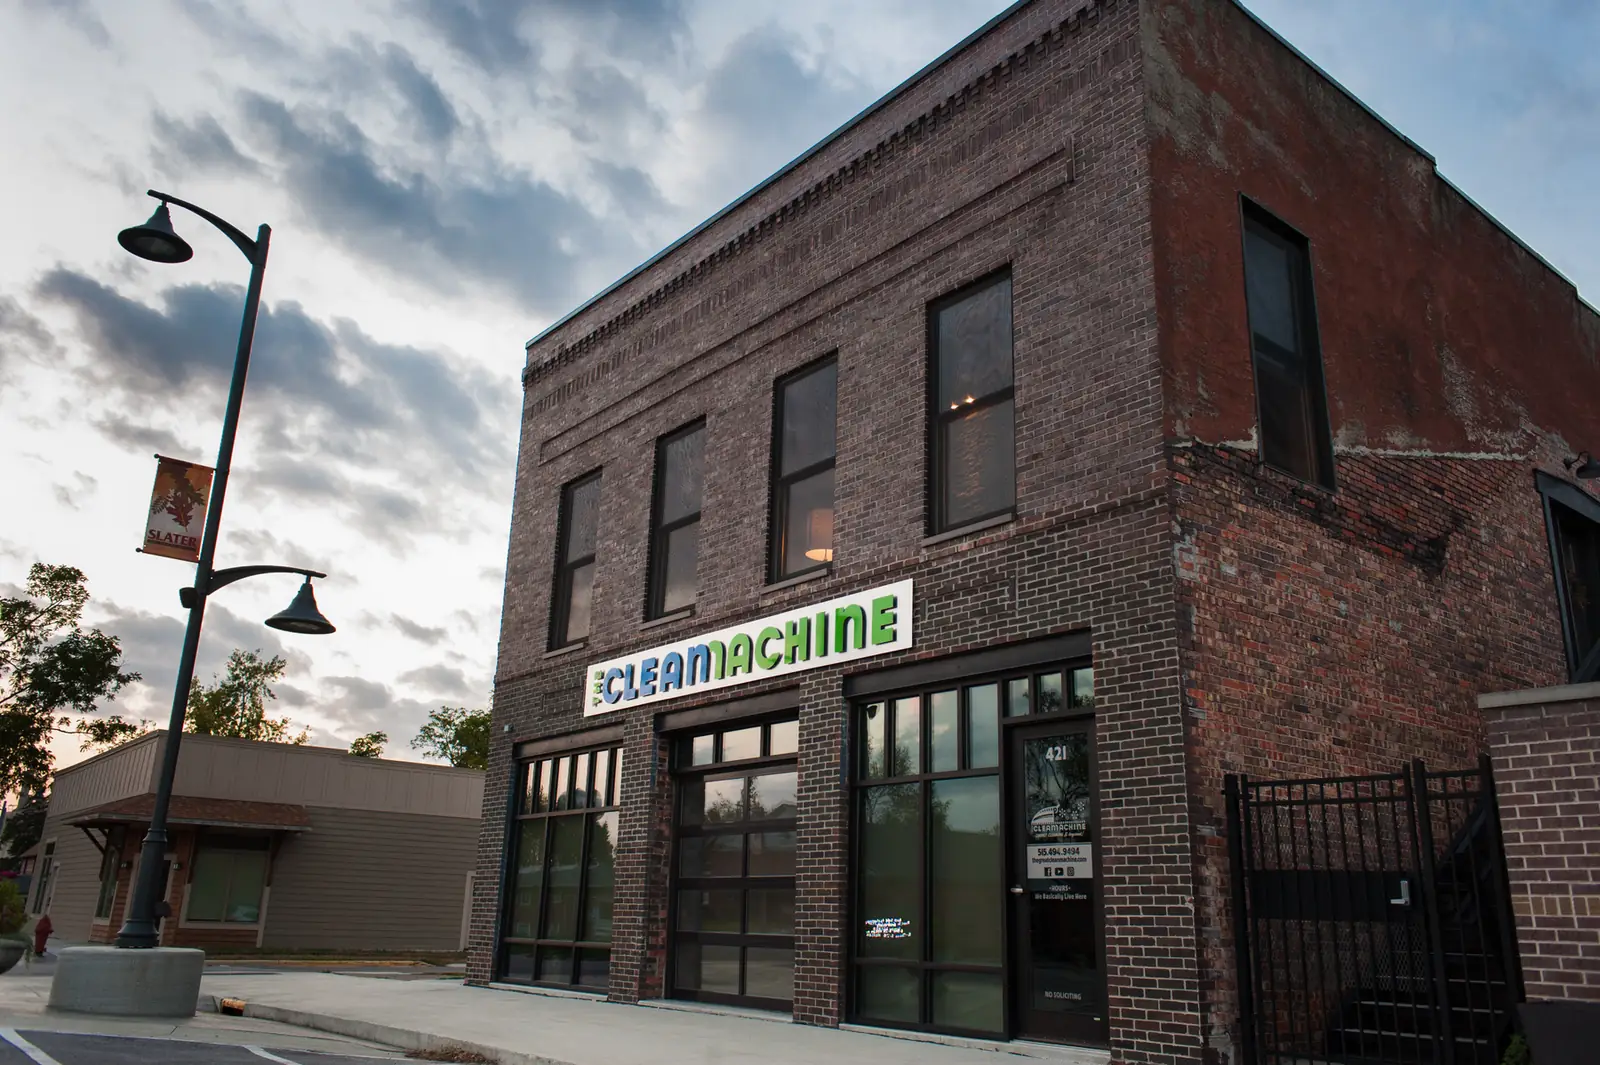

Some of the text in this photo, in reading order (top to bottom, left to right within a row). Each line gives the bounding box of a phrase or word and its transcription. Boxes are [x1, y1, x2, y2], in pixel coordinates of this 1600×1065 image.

[147, 529, 197, 547] SLATER
[1045, 745, 1067, 761] 421
[1044, 990, 1082, 1000] NO SOLICITING
